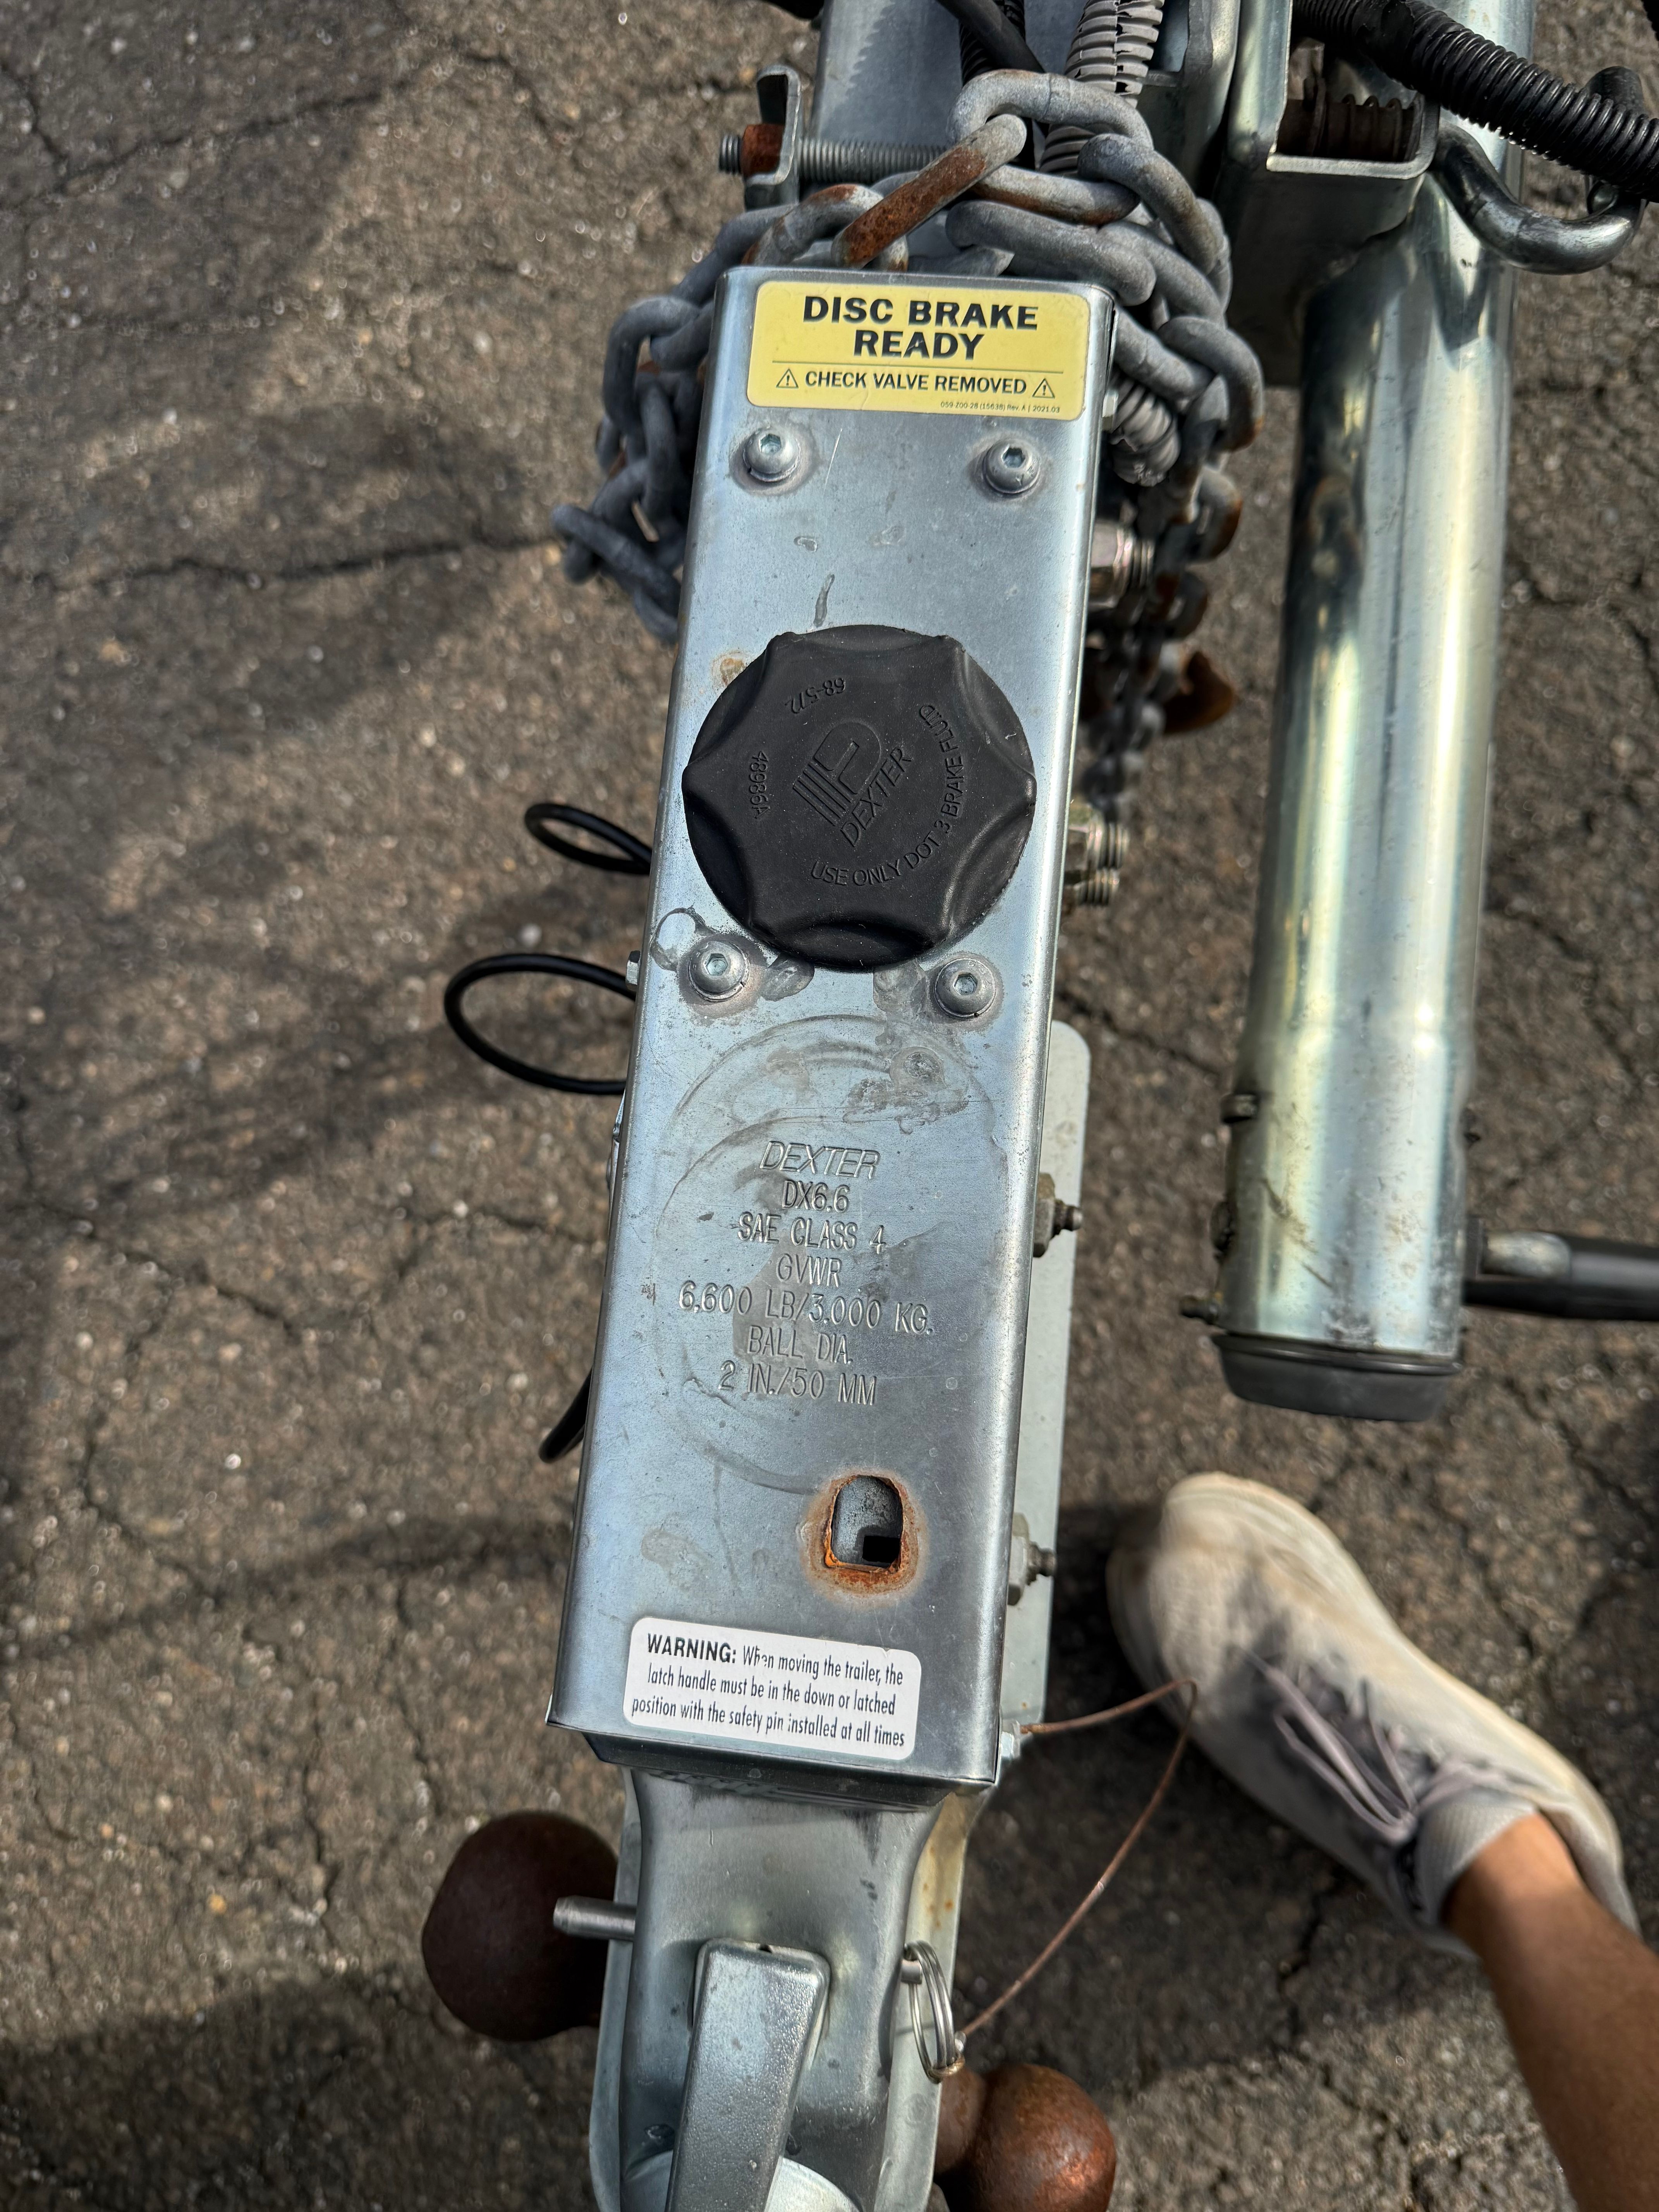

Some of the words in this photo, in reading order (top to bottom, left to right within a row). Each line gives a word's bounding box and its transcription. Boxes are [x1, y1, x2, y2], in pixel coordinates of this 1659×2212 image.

[803, 296, 893, 325] DISC
[908, 300, 1038, 330] BRAKE
[853, 330, 984, 360] READY
[805, 370, 867, 388] CHECK
[872, 373, 929, 391] VALVE
[934, 377, 1027, 395] REMOVED
[785, 677, 846, 714] 68-572
[919, 705, 958, 752] FLUID
[749, 750, 771, 819] 48986A
[840, 747, 913, 848] DEXTER
[940, 756, 964, 817] BRAKE
[934, 819, 950, 834] 3
[903, 831, 941, 869] DOT
[812, 860, 848, 886] USE
[853, 858, 901, 886] ONLY
[759, 1140, 880, 1179] DEXTER
[782, 1179, 850, 1213] DX6.6
[738, 1211, 781, 1244] SAE
[790, 1216, 857, 1251] CLASS
[870, 1224, 886, 1255] 4
[776, 1253, 842, 1288] GVWR
[895, 1302, 933, 1335] KG.
[747, 1325, 804, 1359] BALL
[816, 1333, 853, 1365] DIA.
[718, 1360, 735, 1390] 2
[838, 1372, 877, 1406] MM
[647, 1633, 736, 1664] WARNING:
[778, 1653, 819, 1680] moving
[824, 1655, 841, 1677] the
[845, 1659, 881, 1686] trailer,
[886, 1662, 903, 1686] the
[648, 1662, 674, 1686] latch
[678, 1666, 716, 1691] handle
[720, 1678, 747, 1695] must
[750, 1675, 764, 1697] be
[768, 1680, 778, 1700] in
[783, 1680, 800, 1702] the
[804, 1683, 834, 1707] down
[838, 1695, 850, 1709] or
[854, 1689, 896, 1716] latched
[631, 1695, 677, 1717] position
[681, 1699, 704, 1721] with
[708, 1701, 726, 1723] the
[729, 1705, 763, 1733] safety
[766, 1711, 783, 1735] pin
[787, 1713, 838, 1739] installed
[841, 1723, 852, 1741] at
[856, 1721, 871, 1742] all
[874, 1724, 905, 1747] times
